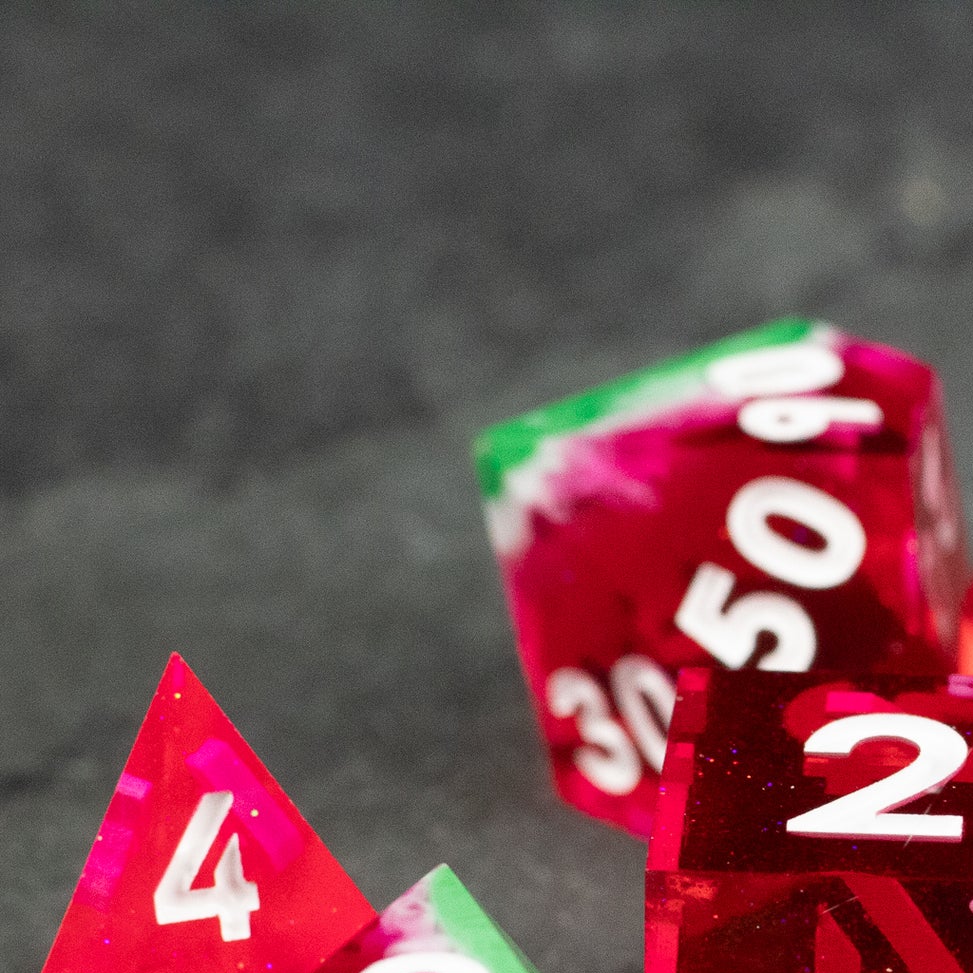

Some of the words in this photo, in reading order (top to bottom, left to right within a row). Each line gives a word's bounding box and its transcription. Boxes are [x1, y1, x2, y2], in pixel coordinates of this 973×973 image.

[705, 344, 884, 442] 90
[675, 475, 867, 672] 50
[786, 713, 968, 842] 2
[153, 791, 261, 942] 4
